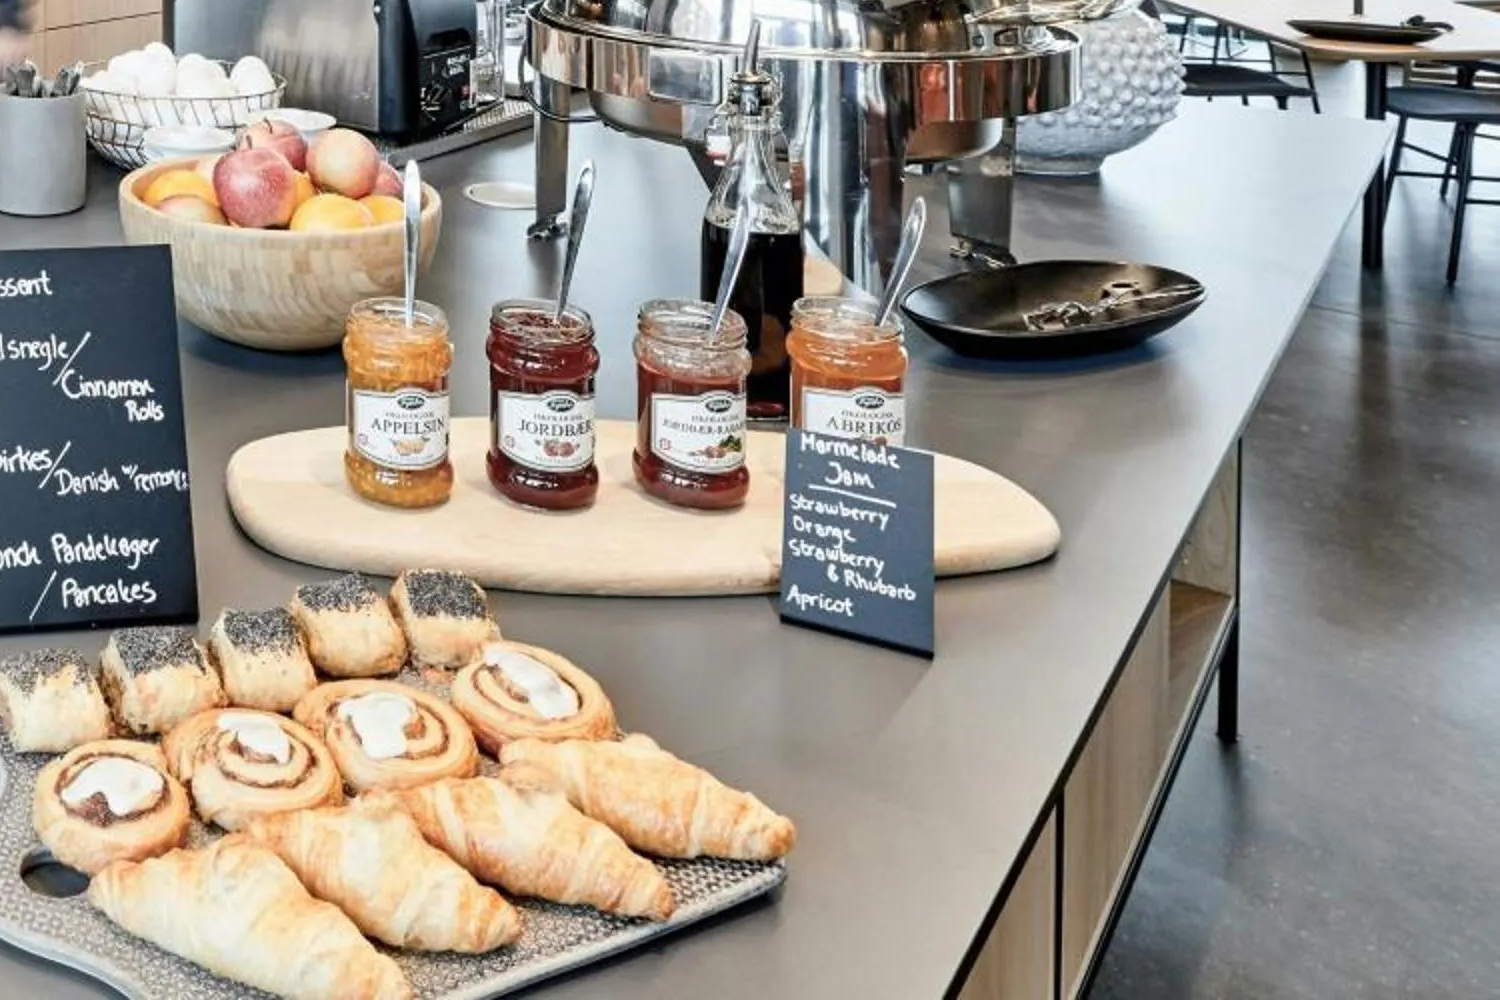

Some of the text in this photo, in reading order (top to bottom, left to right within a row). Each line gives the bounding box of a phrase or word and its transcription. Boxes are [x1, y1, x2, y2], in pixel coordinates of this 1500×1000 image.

[62, 368, 155, 400] Cinnamon
[124, 400, 164, 422] Rolls
[371, 415, 445, 435] APPELSIN
[826, 415, 902, 435] ABRIKOS
[800, 432, 900, 469] Marmelade
[54, 468, 119, 496] Danish
[824, 461, 875, 489] Jam
[789, 493, 889, 531] Strawberry
[793, 515, 856, 549] Orange
[787, 538, 885, 578] Strawberry
[61, 577, 157, 609] Pancakes
[786, 583, 854, 617] Apricot
[843, 568, 917, 601] Rhubarb
